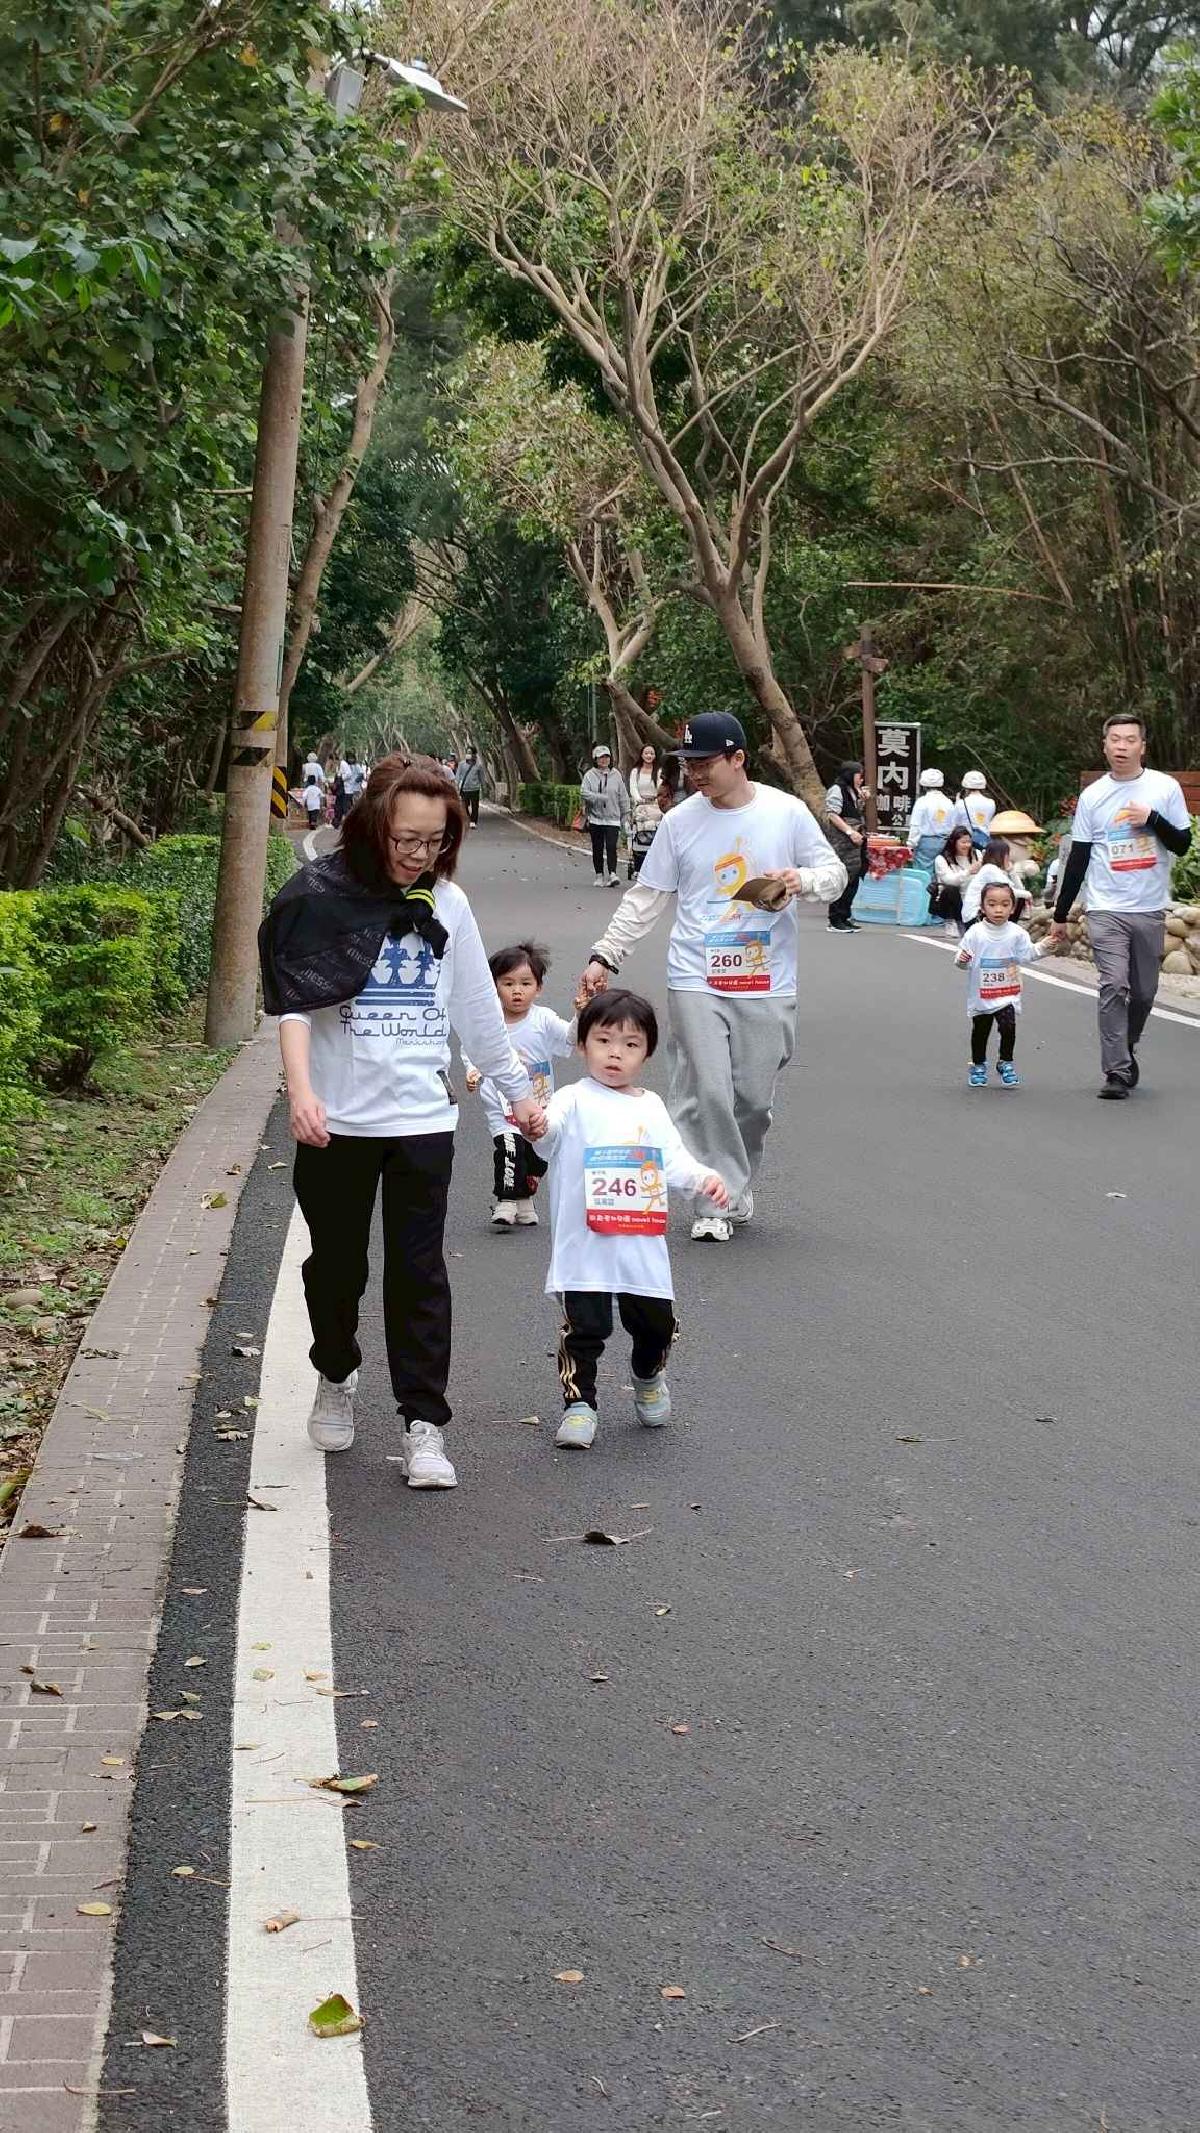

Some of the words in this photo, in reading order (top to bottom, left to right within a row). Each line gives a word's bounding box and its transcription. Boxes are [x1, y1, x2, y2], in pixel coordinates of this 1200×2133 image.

[711, 955, 742, 967] 260
[983, 973, 1005, 982] 238
[340, 1005, 417, 1020] Queen
[422, 1007, 446, 1021] Of
[340, 1020, 380, 1037] The
[381, 1022, 447, 1037] World
[592, 1177, 637, 1197] 246
